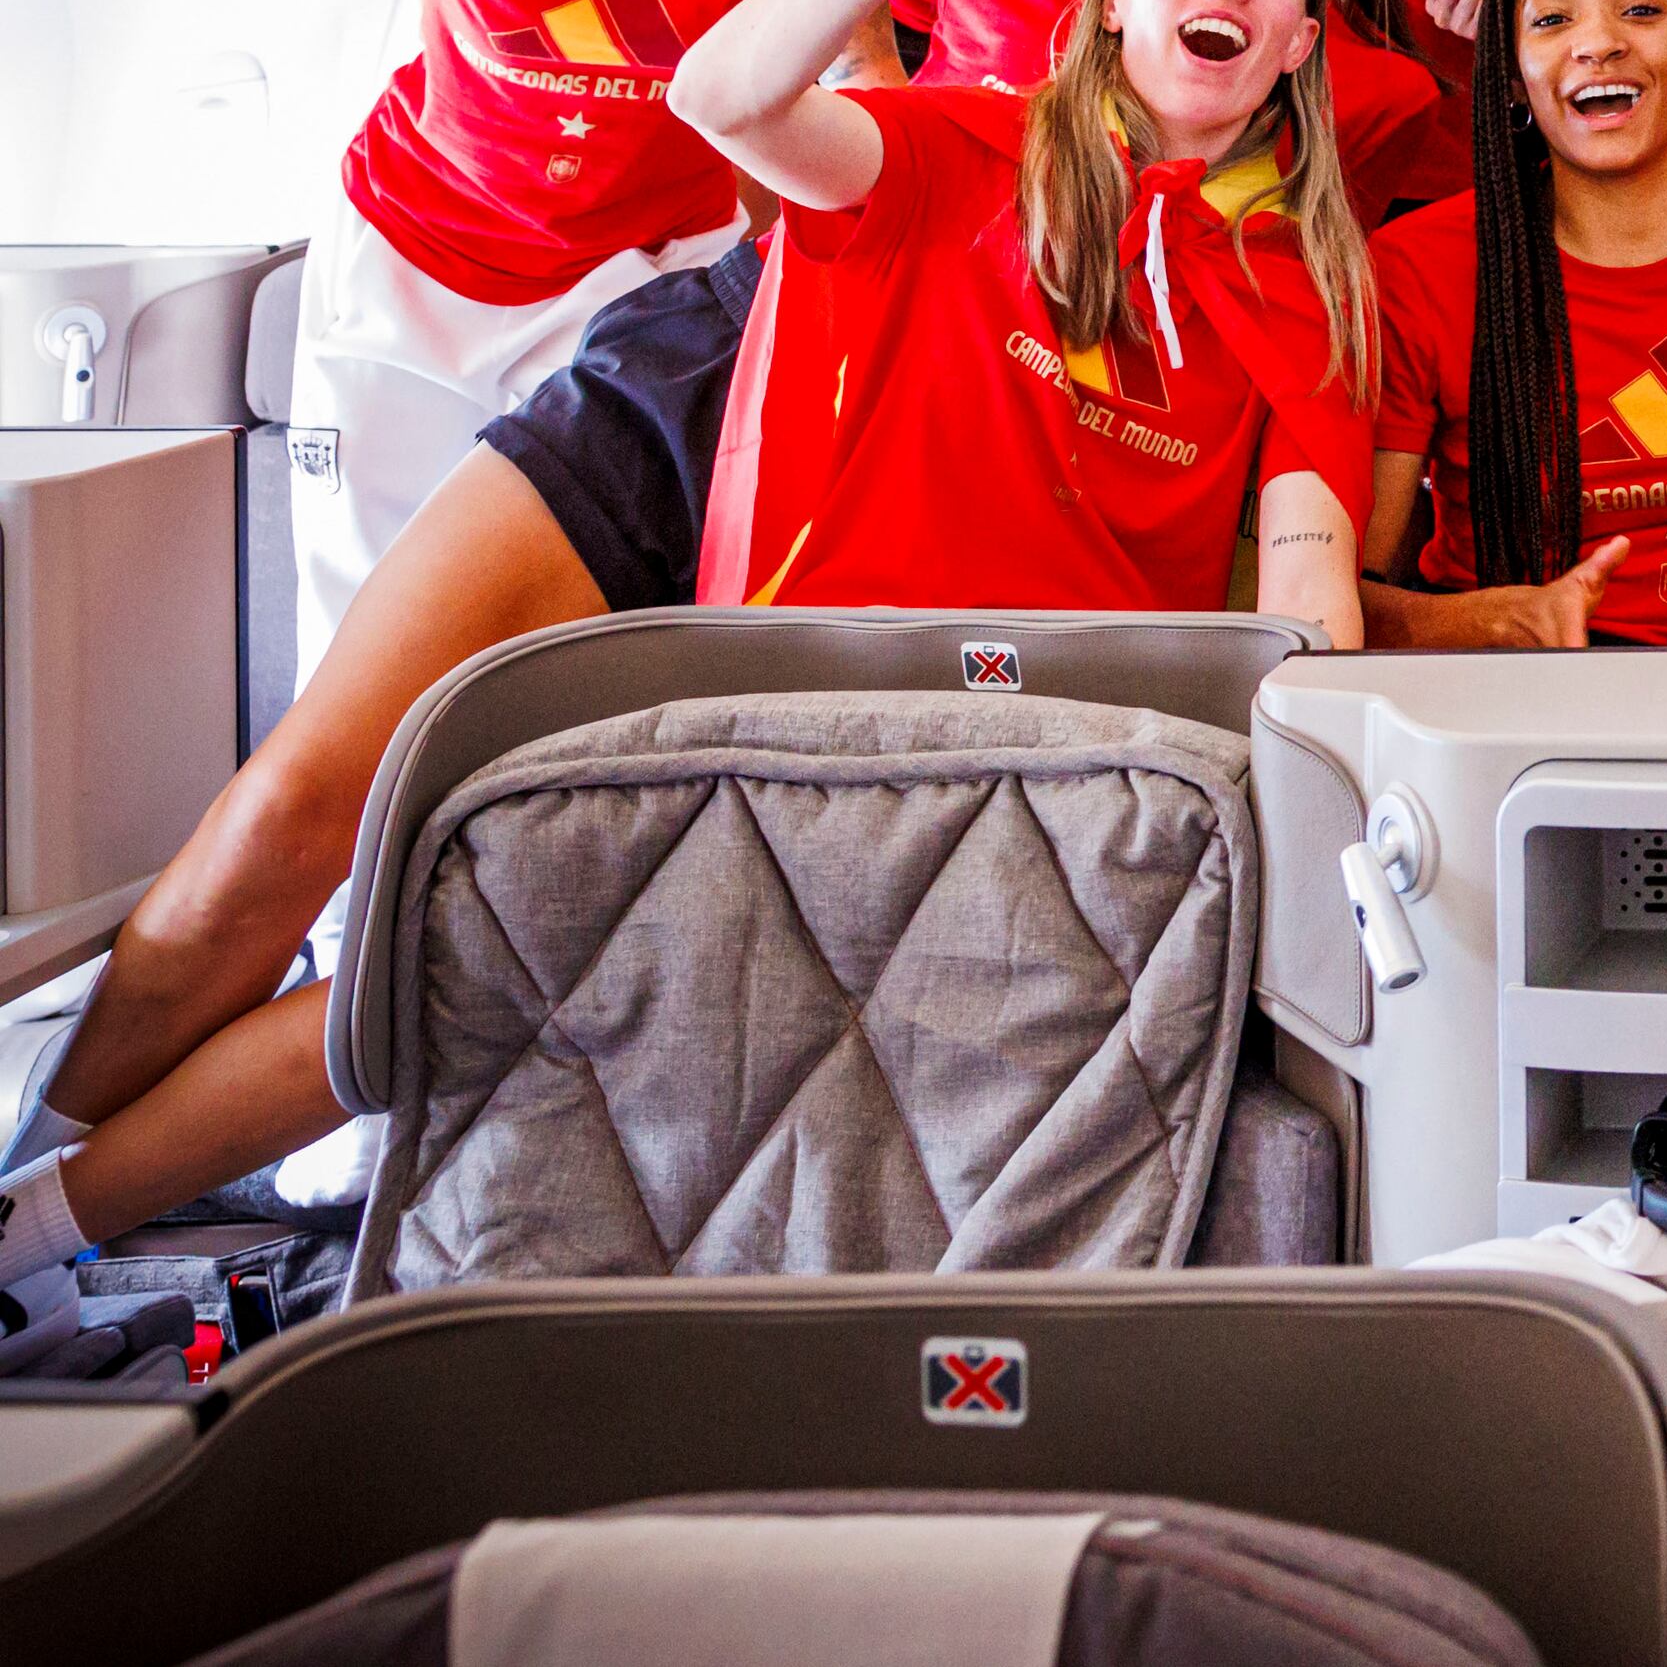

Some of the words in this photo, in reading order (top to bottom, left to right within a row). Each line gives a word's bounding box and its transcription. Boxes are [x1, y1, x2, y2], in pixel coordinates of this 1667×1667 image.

[593, 77, 640, 100] DEL
[1077, 400, 1116, 438] DEL
[1119, 420, 1199, 466] MUNDO
